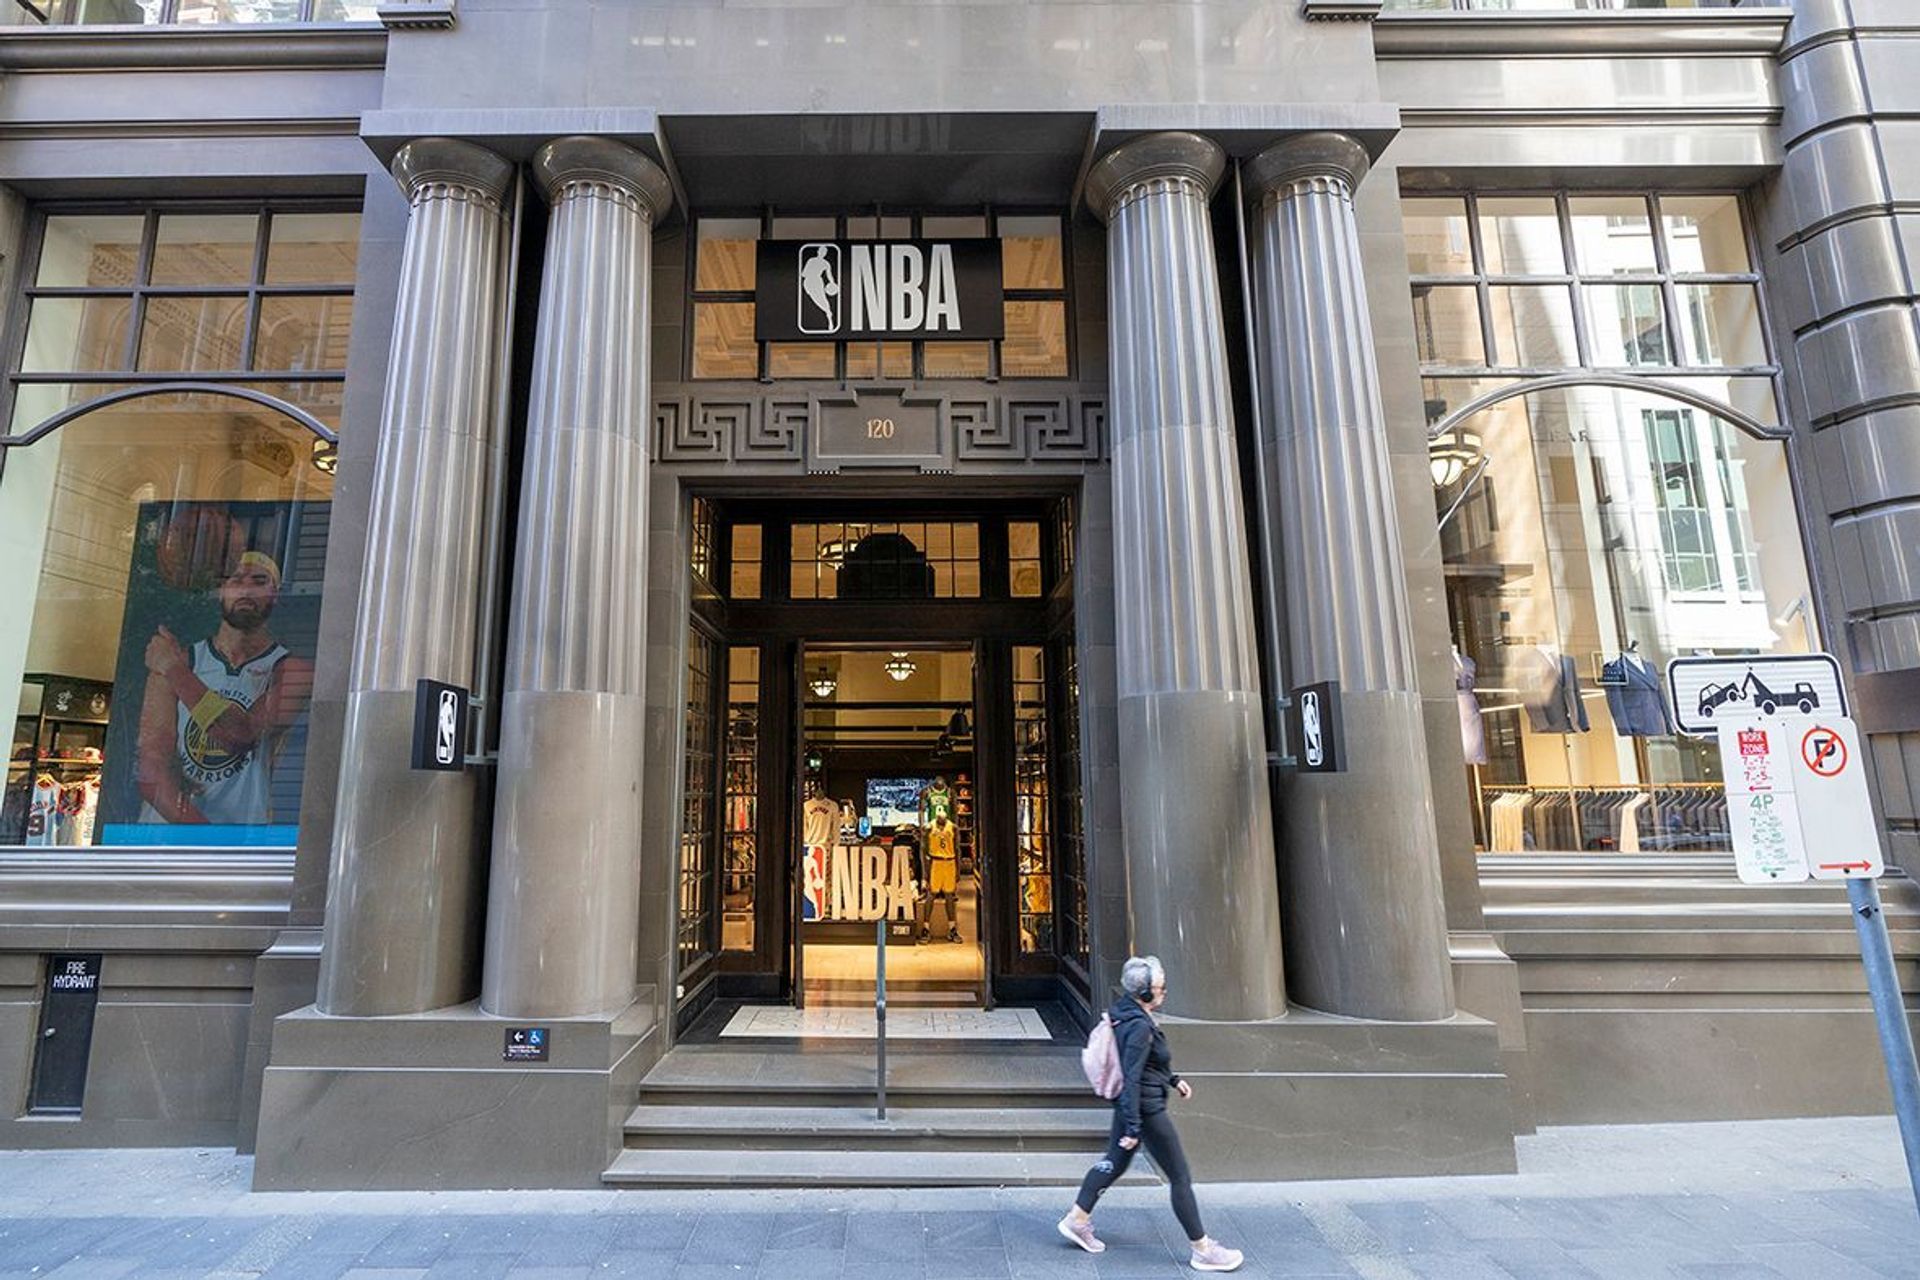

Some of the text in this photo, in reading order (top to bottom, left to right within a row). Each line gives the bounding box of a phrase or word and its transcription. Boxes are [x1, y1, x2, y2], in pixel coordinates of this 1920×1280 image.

[851, 244, 962, 331] NBA
[868, 419, 894, 438] 120
[1750, 794, 1774, 809] 4P
[832, 846, 915, 920] NBA
[53, 975, 96, 988] HYDRANT
